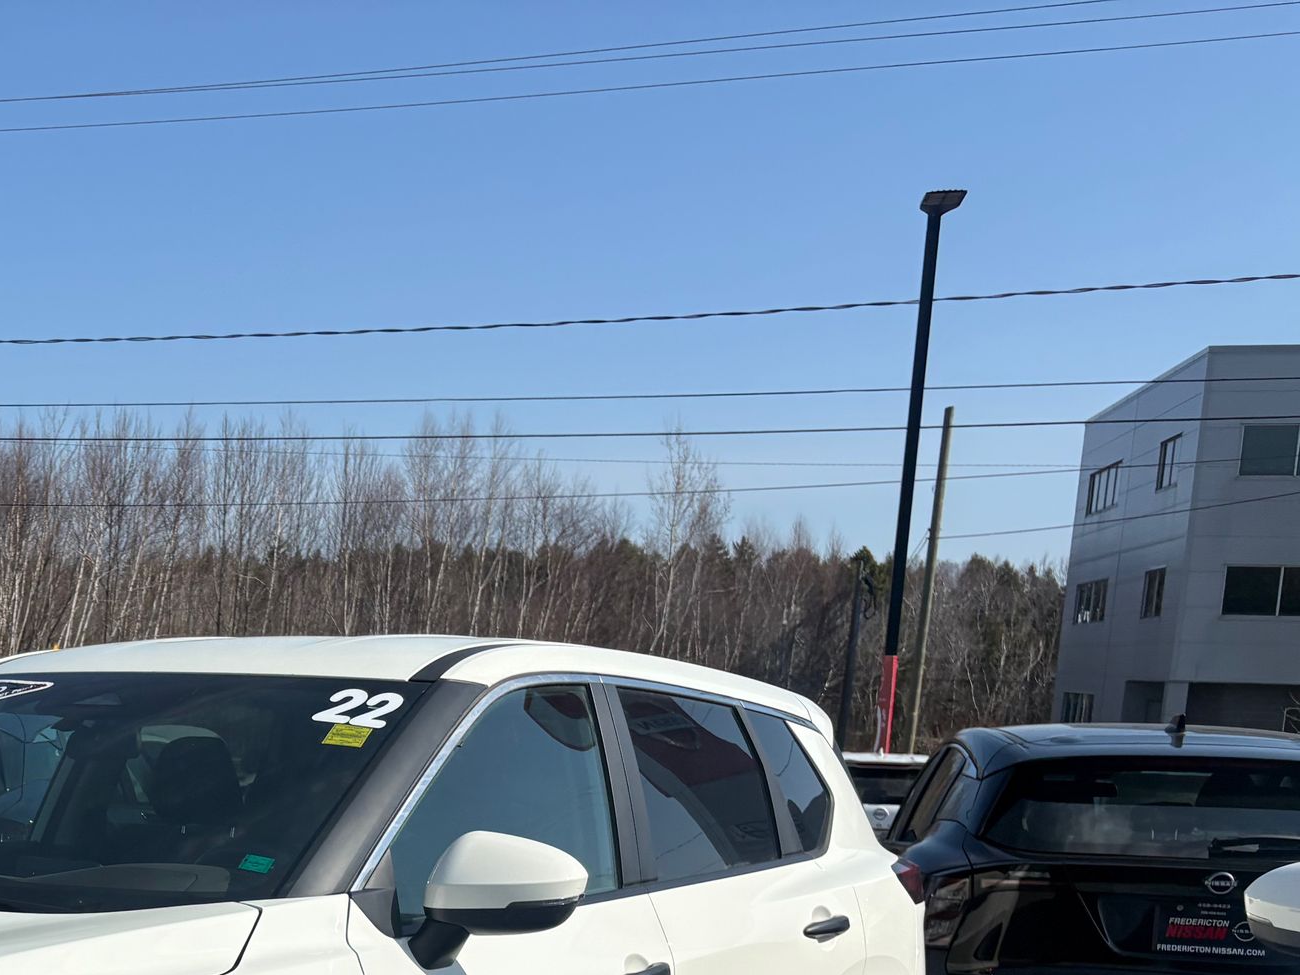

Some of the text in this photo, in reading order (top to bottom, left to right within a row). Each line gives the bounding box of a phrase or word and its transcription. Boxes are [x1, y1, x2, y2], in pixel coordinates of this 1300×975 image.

[311, 688, 404, 729] 22
[1168, 917, 1230, 928] FREDERICTON
[1165, 925, 1229, 940] NISSAN
